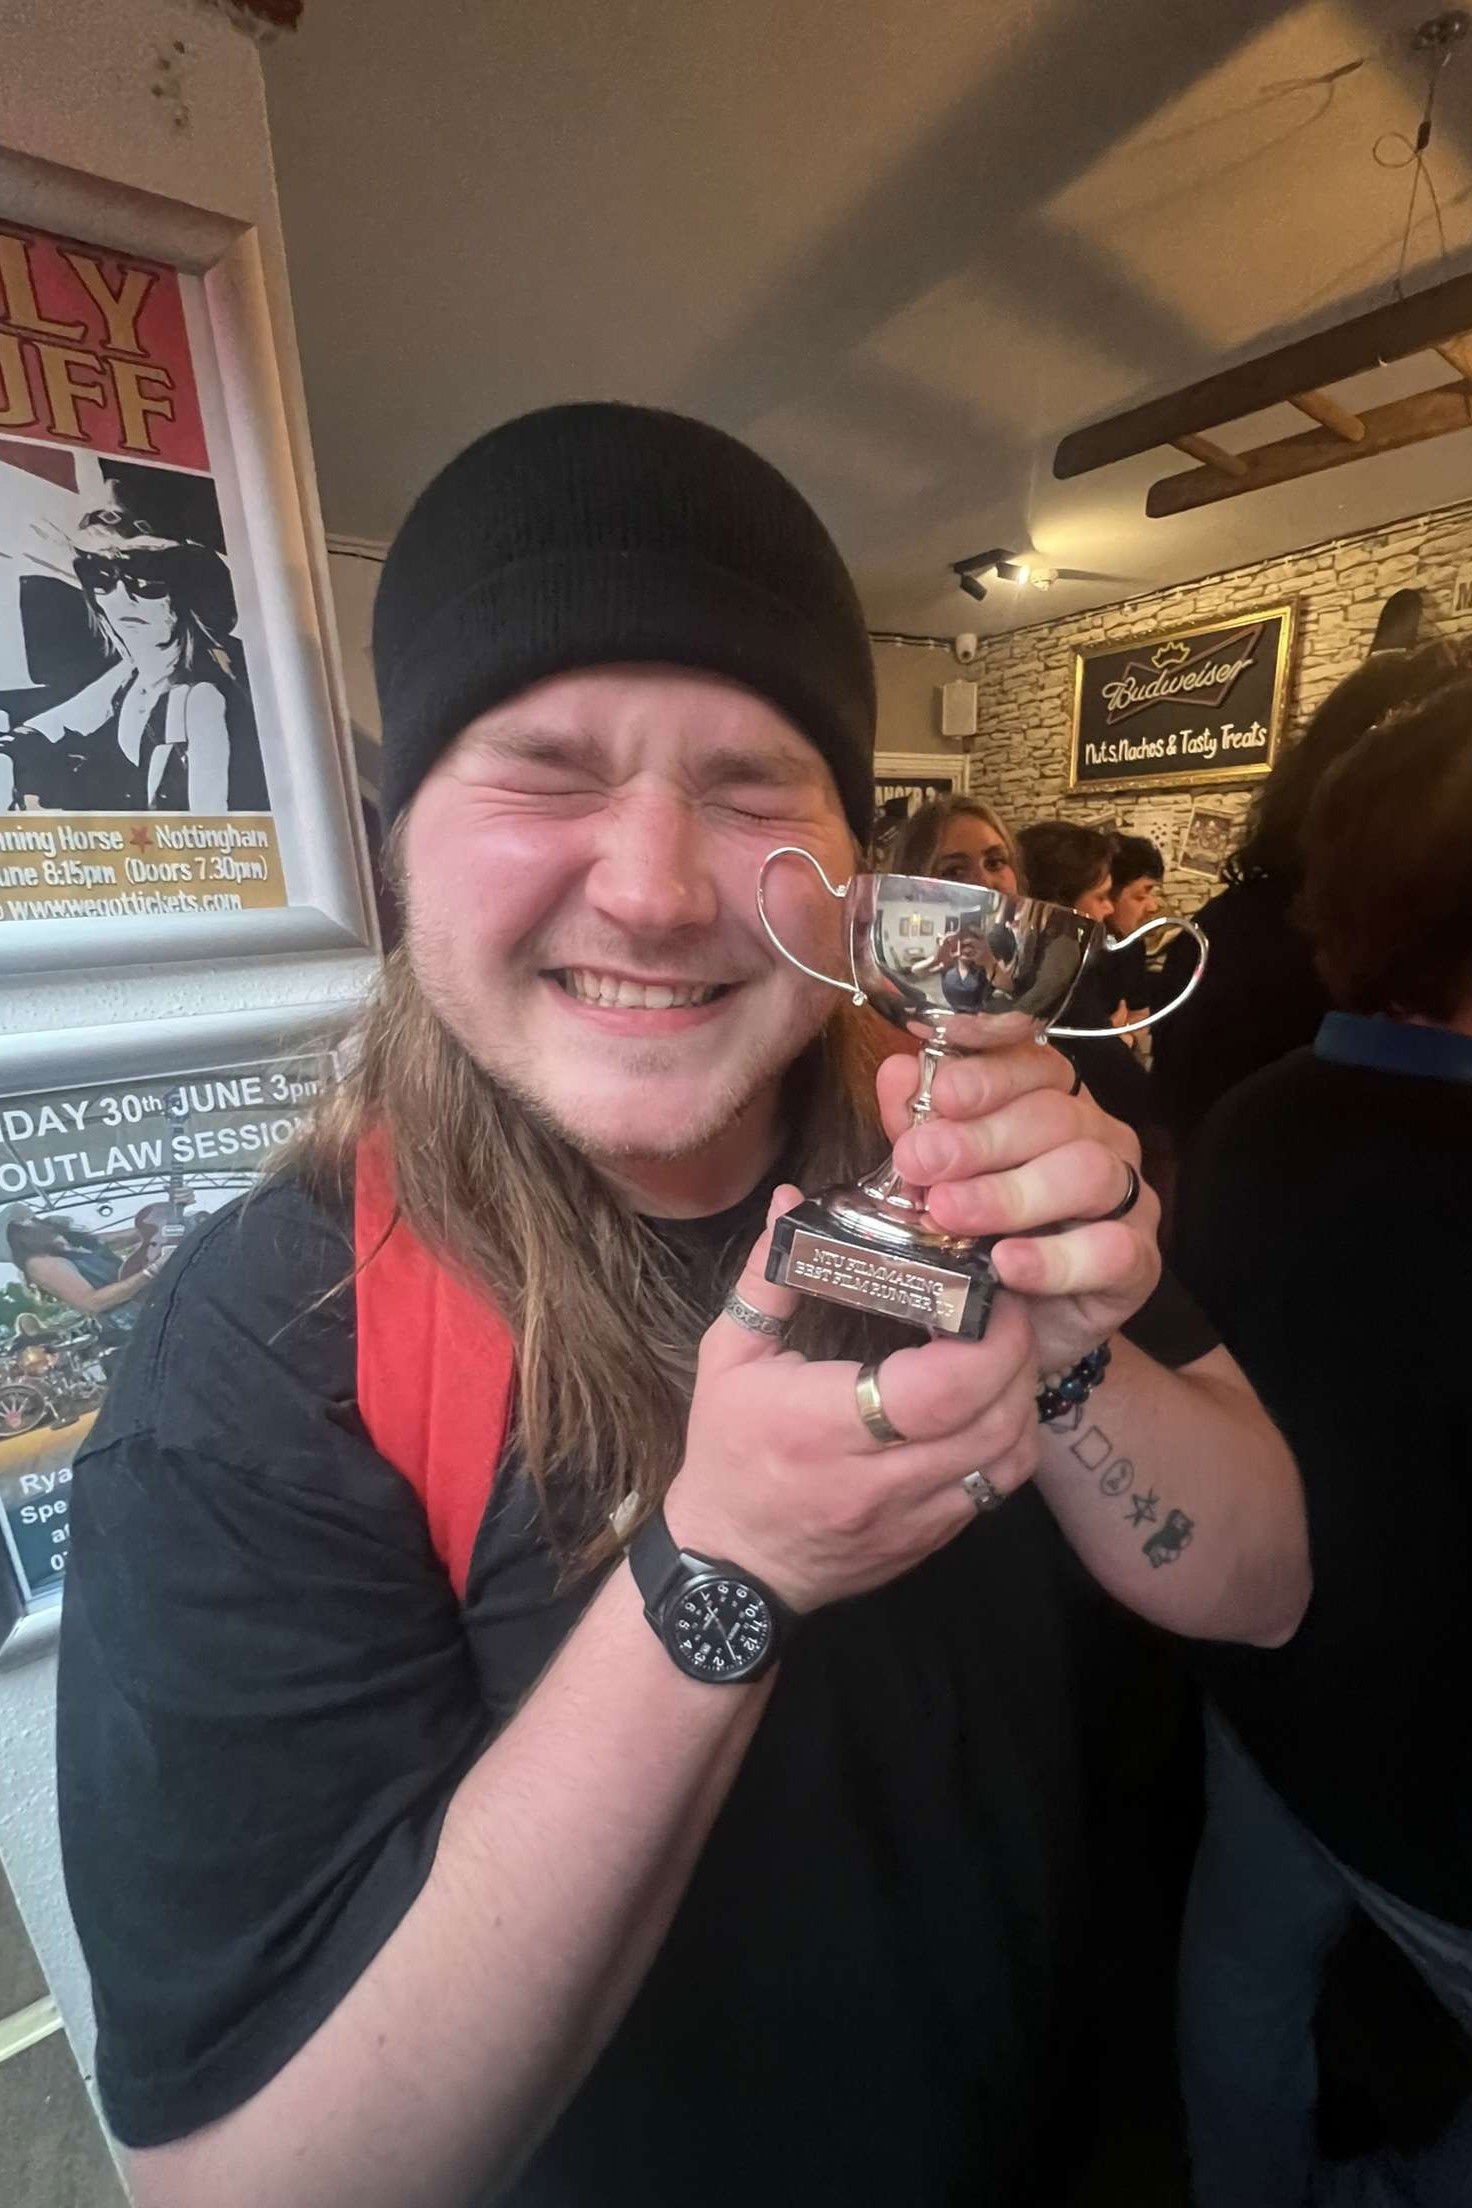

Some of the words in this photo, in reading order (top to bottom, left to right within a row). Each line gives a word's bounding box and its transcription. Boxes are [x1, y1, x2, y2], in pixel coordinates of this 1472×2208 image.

[1102, 658, 1254, 712] Budweiser
[1166, 734, 1178, 756] &
[1179, 727, 1218, 760] Tasty
[1220, 720, 1268, 750] Treats
[57, 825, 125, 851] Horse
[154, 823, 268, 854] Nottingham
[124, 857, 193, 885] (Doors
[0, 1099, 89, 1142] DAY
[171, 1076, 264, 1117] JUNE
[0, 1138, 163, 1192] OUTLAW
[868, 1281, 933, 1312] RUNNER
